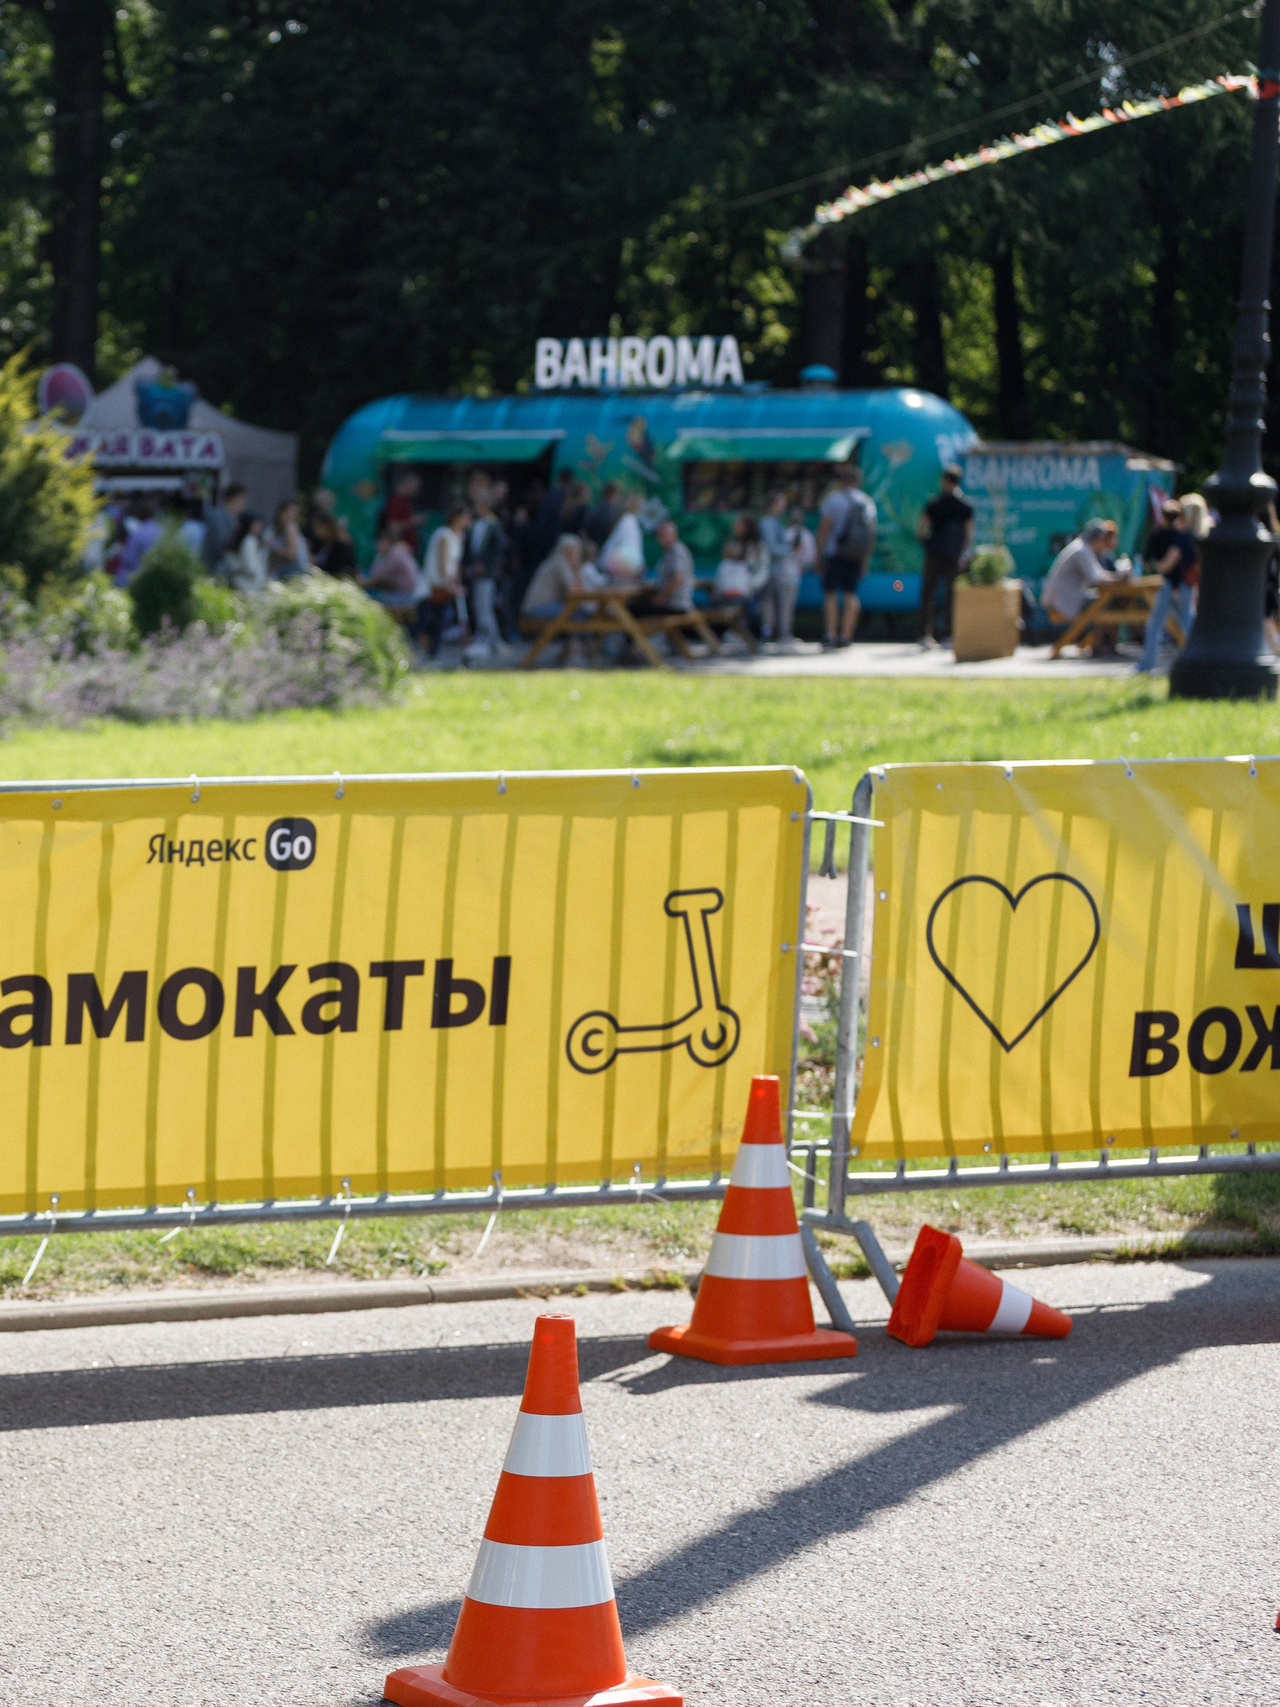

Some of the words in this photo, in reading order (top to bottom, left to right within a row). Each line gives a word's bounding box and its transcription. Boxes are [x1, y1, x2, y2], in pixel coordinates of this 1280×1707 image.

[535, 335, 745, 389] BAHROMA
[965, 455, 1102, 492] BAHROMA
[146, 833, 257, 867] Яндекс
[270, 828, 312, 861] Go
